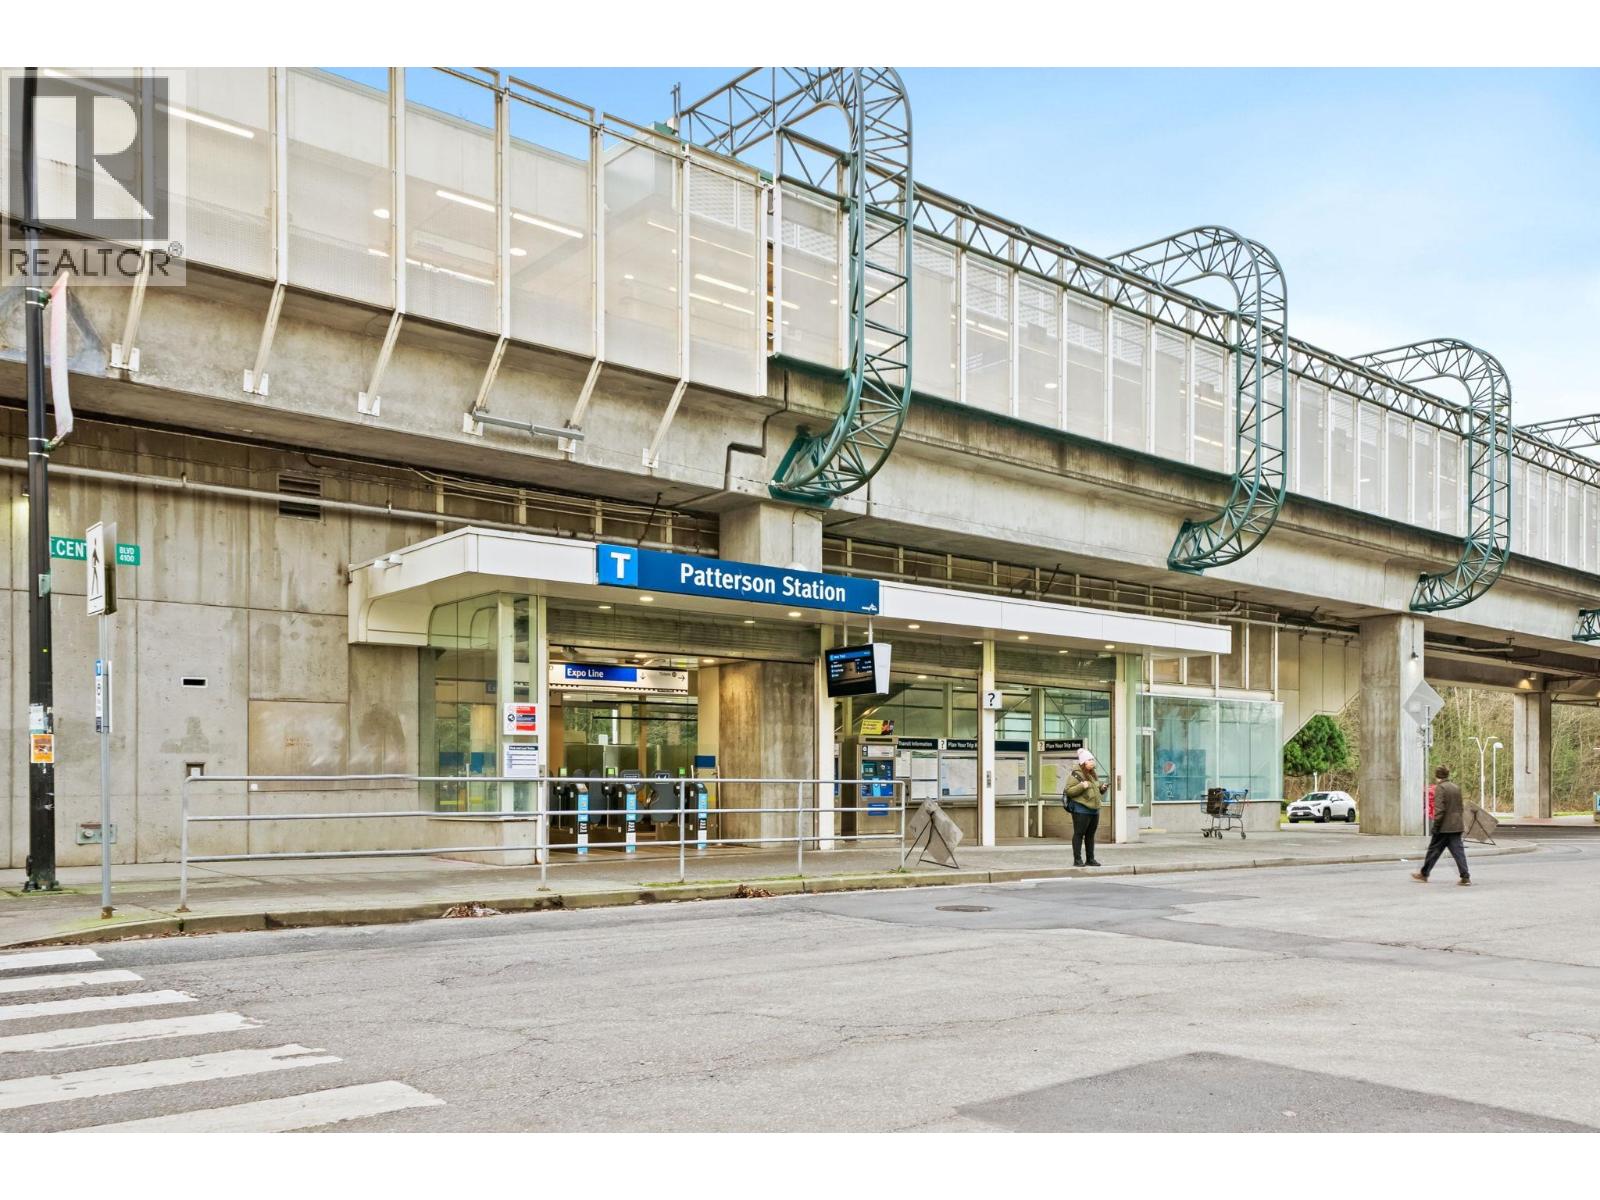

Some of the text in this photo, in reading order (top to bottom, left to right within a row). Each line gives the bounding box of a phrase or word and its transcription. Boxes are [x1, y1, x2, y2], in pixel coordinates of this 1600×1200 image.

[120, 546, 134, 555] BLVD
[611, 551, 631, 579] T
[680, 563, 846, 602] Patterson Station
[567, 667, 604, 678] Expo Line
[988, 693, 996, 707] ?
